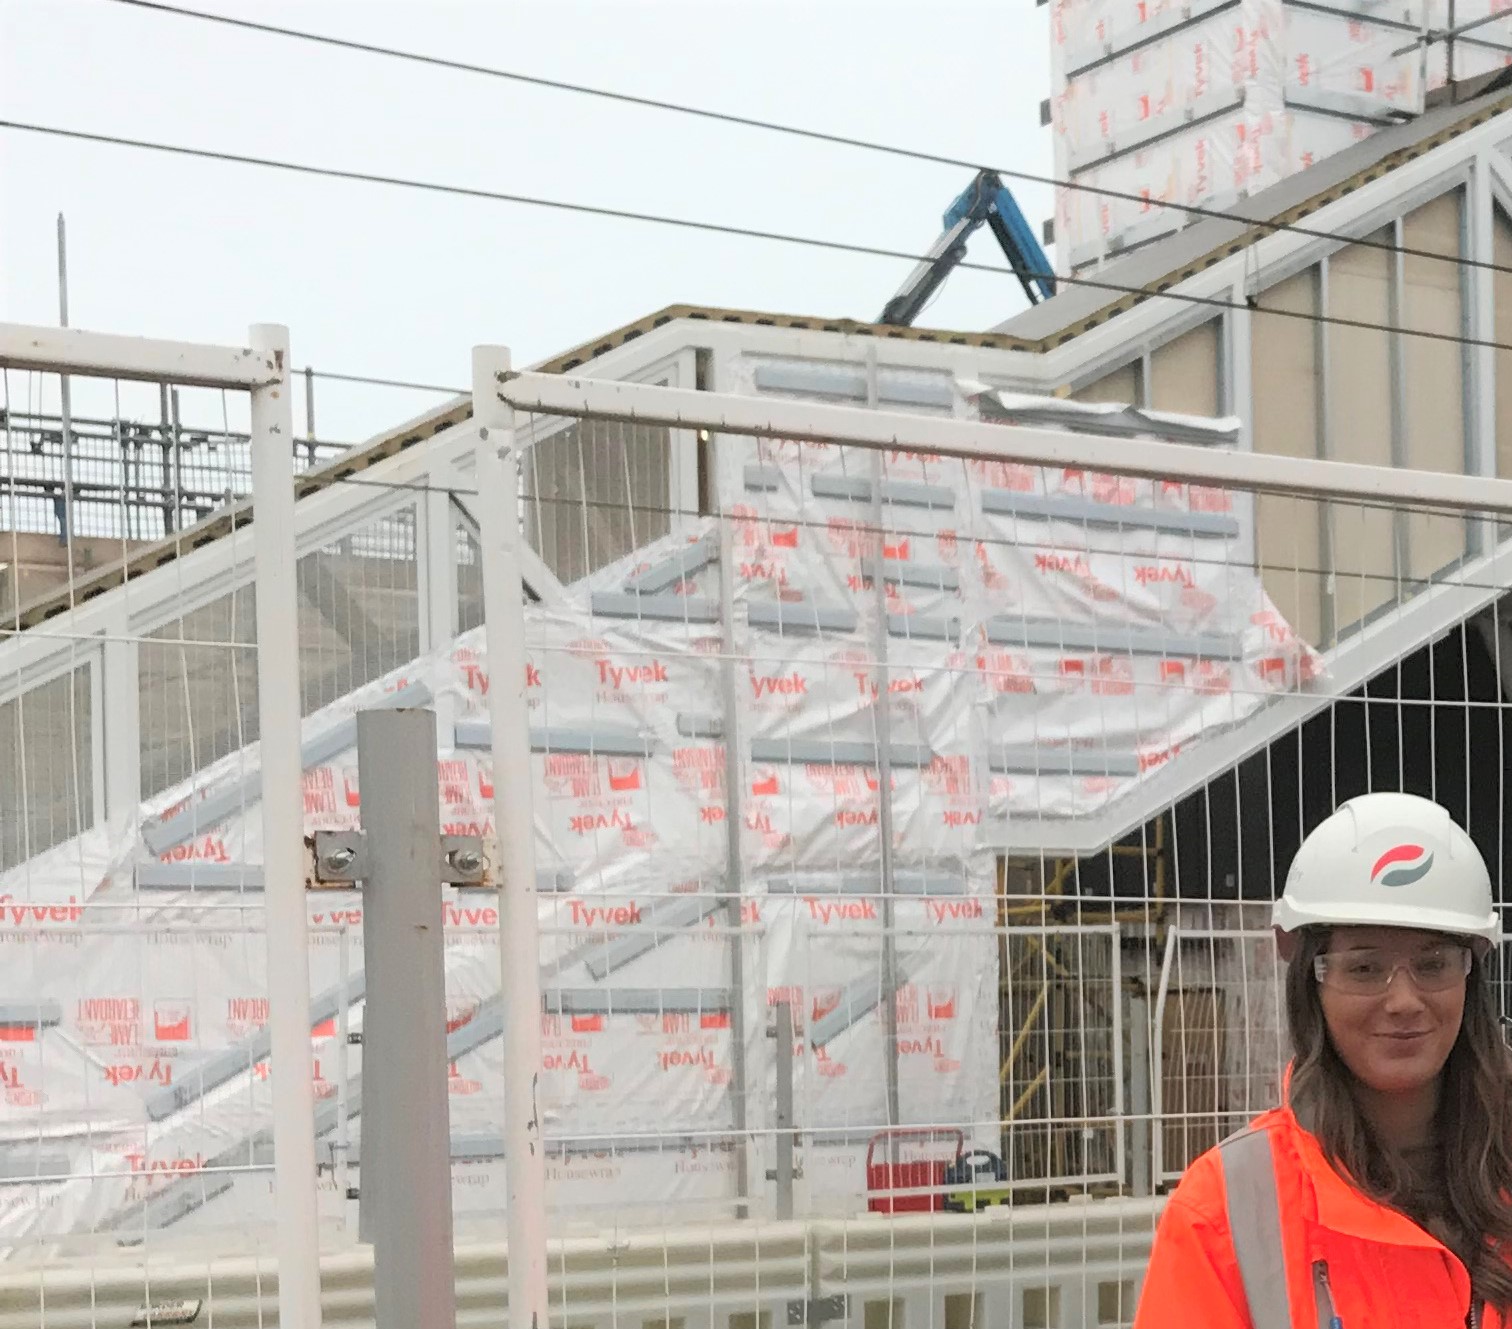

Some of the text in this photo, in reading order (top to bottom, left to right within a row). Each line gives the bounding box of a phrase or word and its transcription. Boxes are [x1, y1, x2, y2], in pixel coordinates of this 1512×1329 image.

[1134, 566, 1195, 589] Tyvek
[595, 659, 668, 689] Tyvek
[750, 672, 808, 699] yvek
[569, 806, 638, 835] Tyvek
[835, 807, 878, 829] yvek
[442, 901, 498, 926] Tyve
[568, 900, 643, 927] Tyvek
[803, 897, 877, 925] Tyvek
[104, 1058, 173, 1087] Tyvek
[543, 1050, 591, 1074] Tyve
